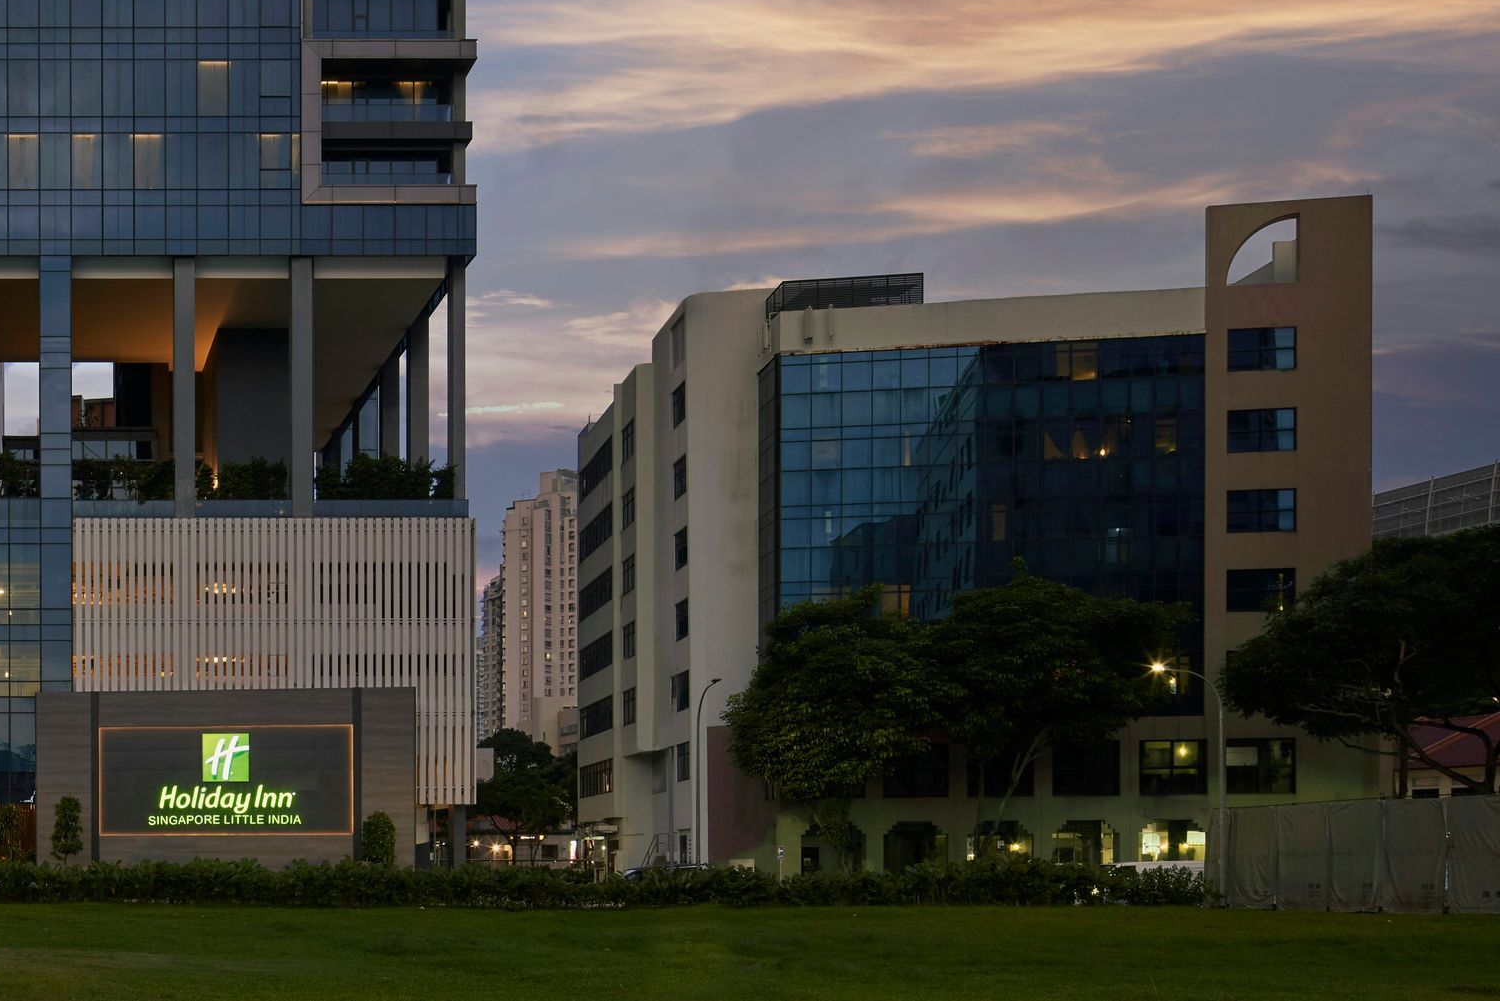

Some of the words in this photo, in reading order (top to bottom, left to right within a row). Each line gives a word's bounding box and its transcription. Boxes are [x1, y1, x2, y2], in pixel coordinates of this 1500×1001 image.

[159, 785, 251, 814] Holiday
[254, 784, 294, 808] Inn
[148, 815, 221, 826] SINGAPORE
[224, 815, 265, 825] LITTLE
[268, 814, 302, 825] INDIA
